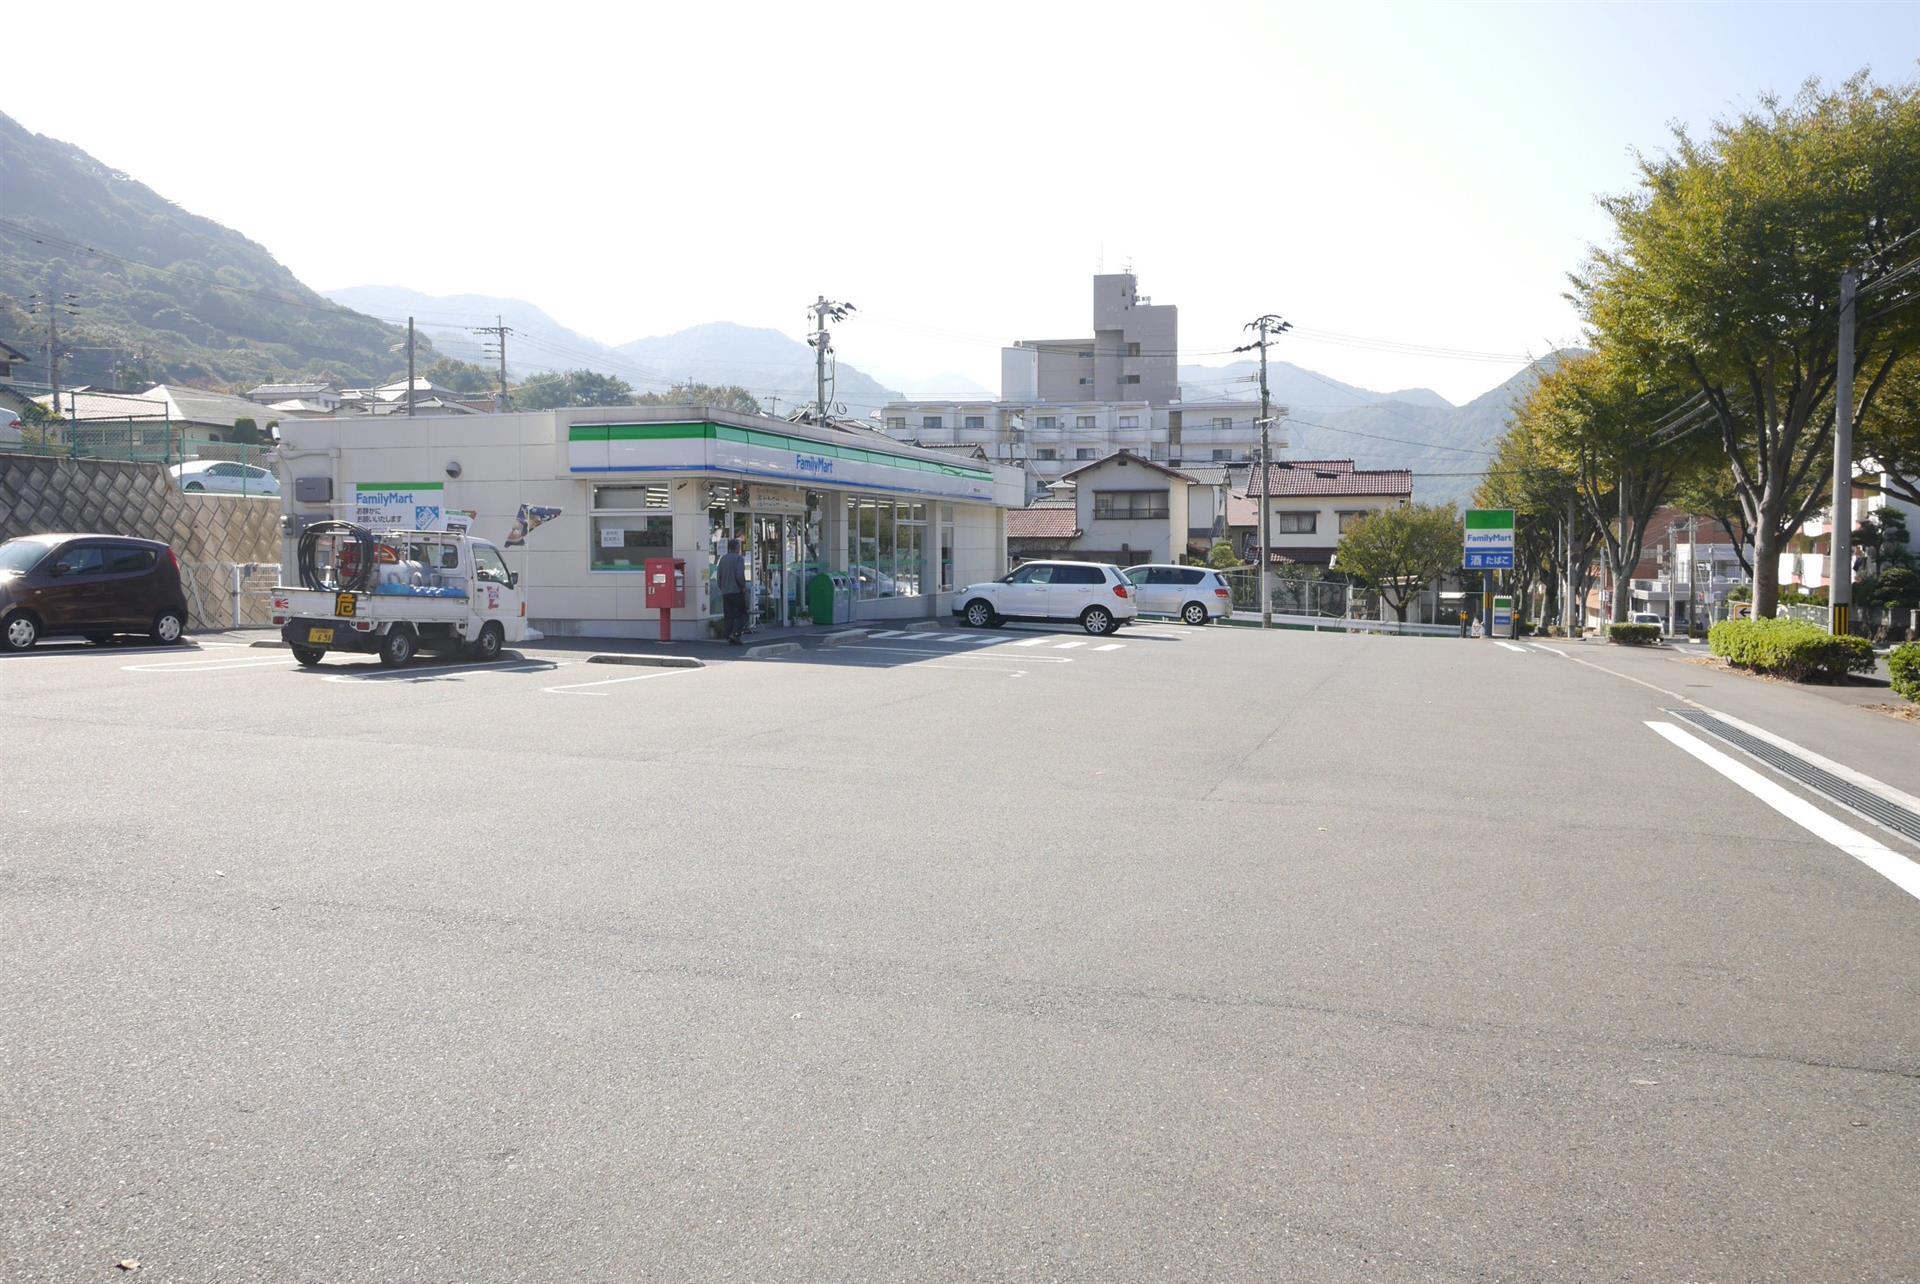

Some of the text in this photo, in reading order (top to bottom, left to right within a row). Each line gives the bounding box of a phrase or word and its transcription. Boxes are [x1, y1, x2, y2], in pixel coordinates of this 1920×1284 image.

[796, 454, 833, 475] FamilyMart
[356, 492, 413, 506] FamilyMart
[1467, 534, 1512, 543] FamilyMart
[1470, 555, 1510, 566] 酒 たばこ
[336, 593, 355, 617] 危
